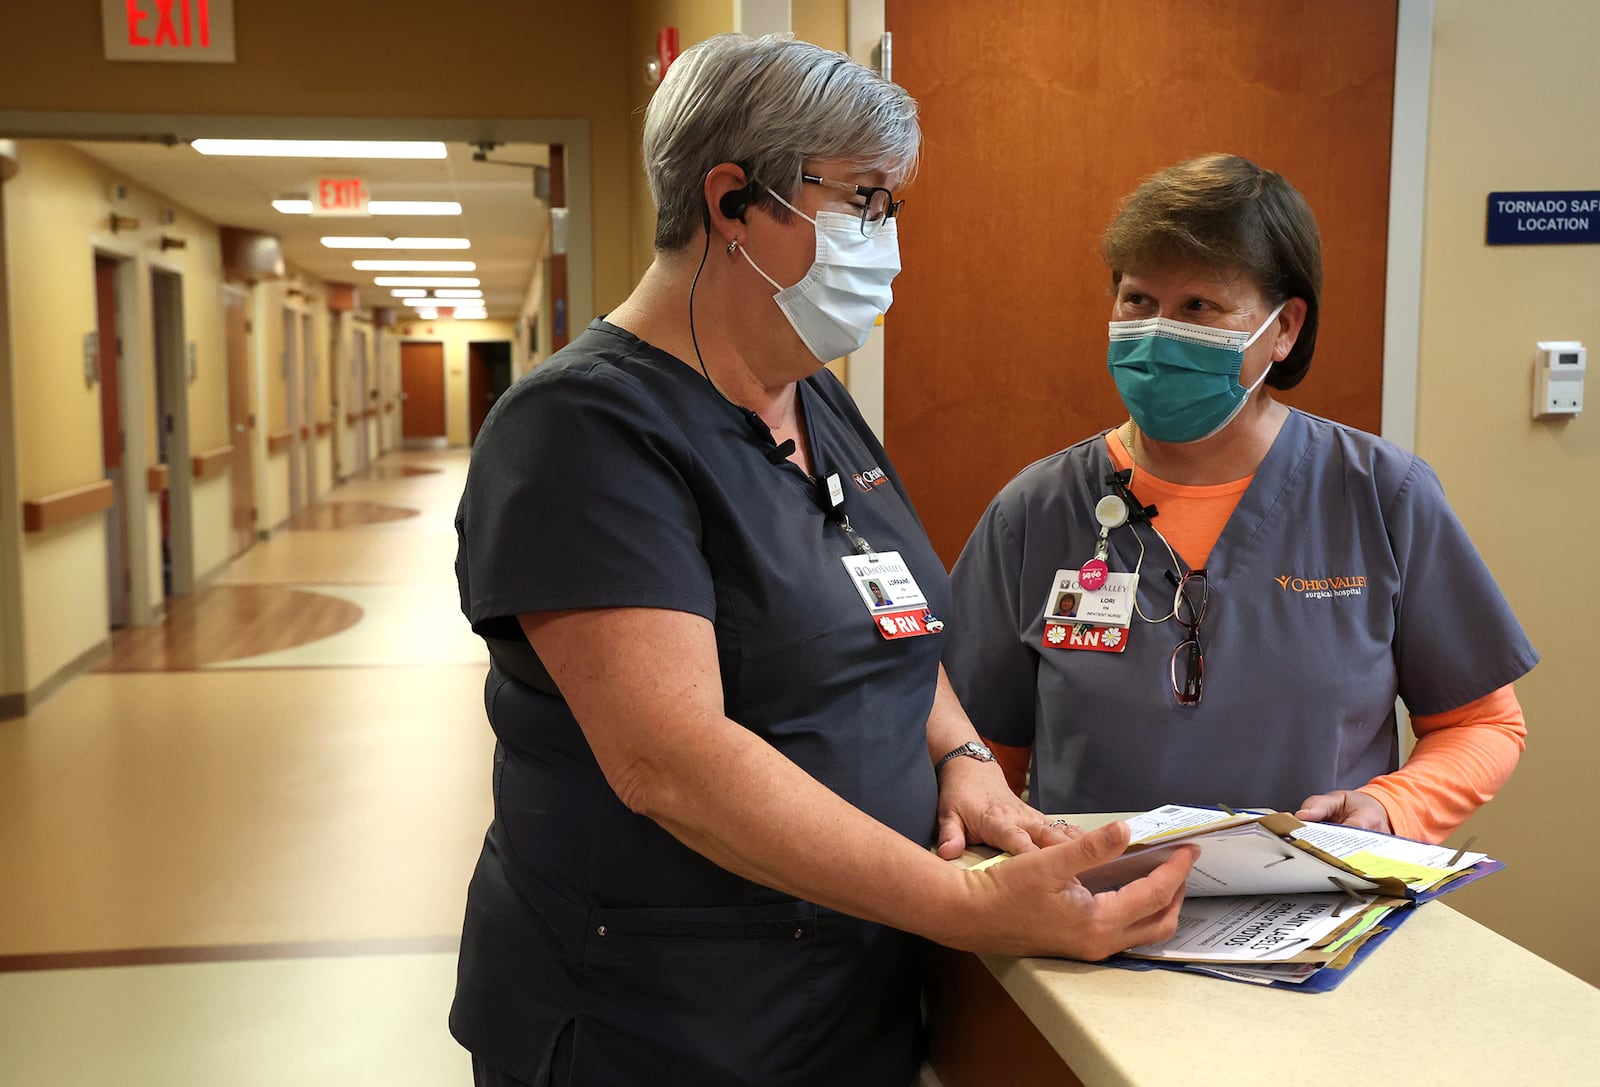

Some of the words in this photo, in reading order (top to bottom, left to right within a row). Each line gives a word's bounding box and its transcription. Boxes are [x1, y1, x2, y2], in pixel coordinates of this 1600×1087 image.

[126, 0, 210, 47] EXIT
[319, 179, 361, 208] EXIT
[1497, 201, 1567, 213] TORNADO
[1570, 200, 1600, 212] SAF
[1517, 218, 1589, 231] LOCATION
[888, 578, 910, 586] LORRAINE
[1305, 590, 1333, 599] surgical
[1334, 587, 1361, 597] hospital
[894, 616, 920, 632] RN
[1069, 630, 1100, 646] RN
[1225, 921, 1274, 946] PHOTOS
[1250, 927, 1295, 950] LABELS
